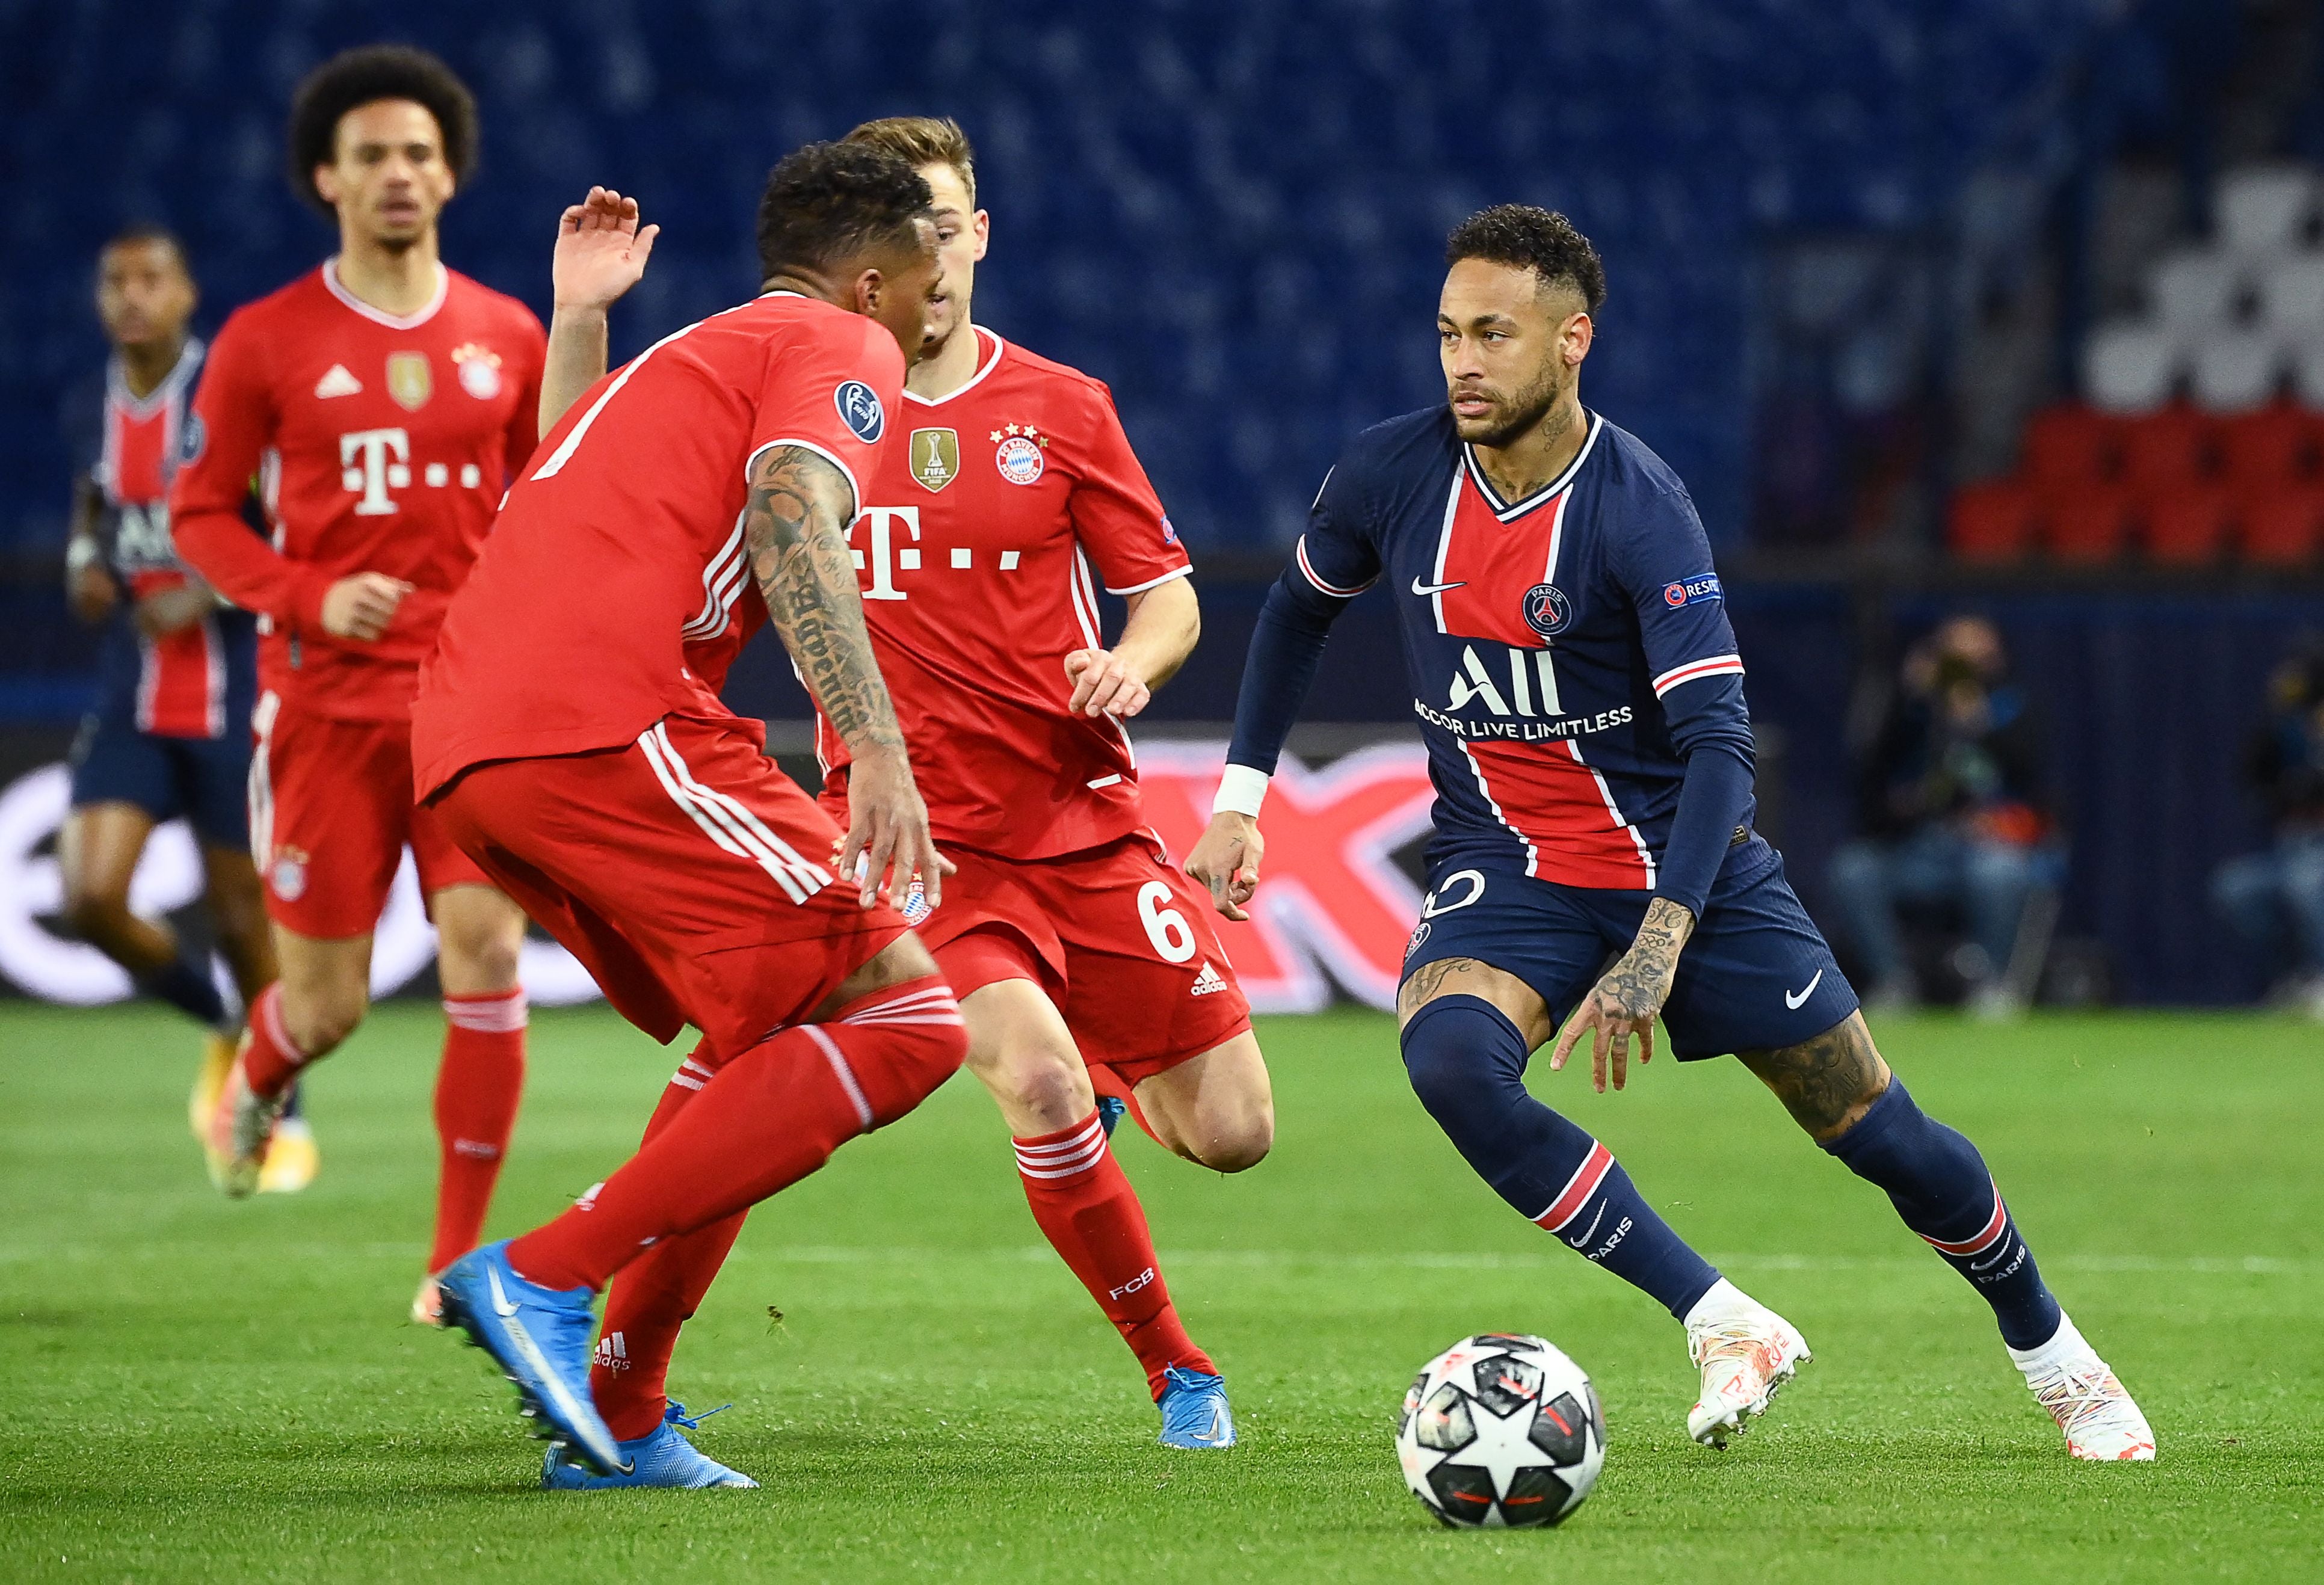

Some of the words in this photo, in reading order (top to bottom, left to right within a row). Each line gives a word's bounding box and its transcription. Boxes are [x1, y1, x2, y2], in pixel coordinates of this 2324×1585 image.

[1009, 440, 1039, 460] BAYERN
[924, 467, 946, 476] FIFA
[1531, 588, 1563, 602] PARIS
[1414, 698, 1466, 736] ACCOR
[1470, 721, 1520, 738] LIVE
[1524, 706, 1633, 740] LIMITLESS
[1137, 881, 1196, 962] 6
[1191, 981, 1227, 996] adidas
[1588, 1216, 1633, 1261] PARIS
[1978, 1245, 2025, 1283] PARIS
[1109, 1267, 1154, 1300] FCB
